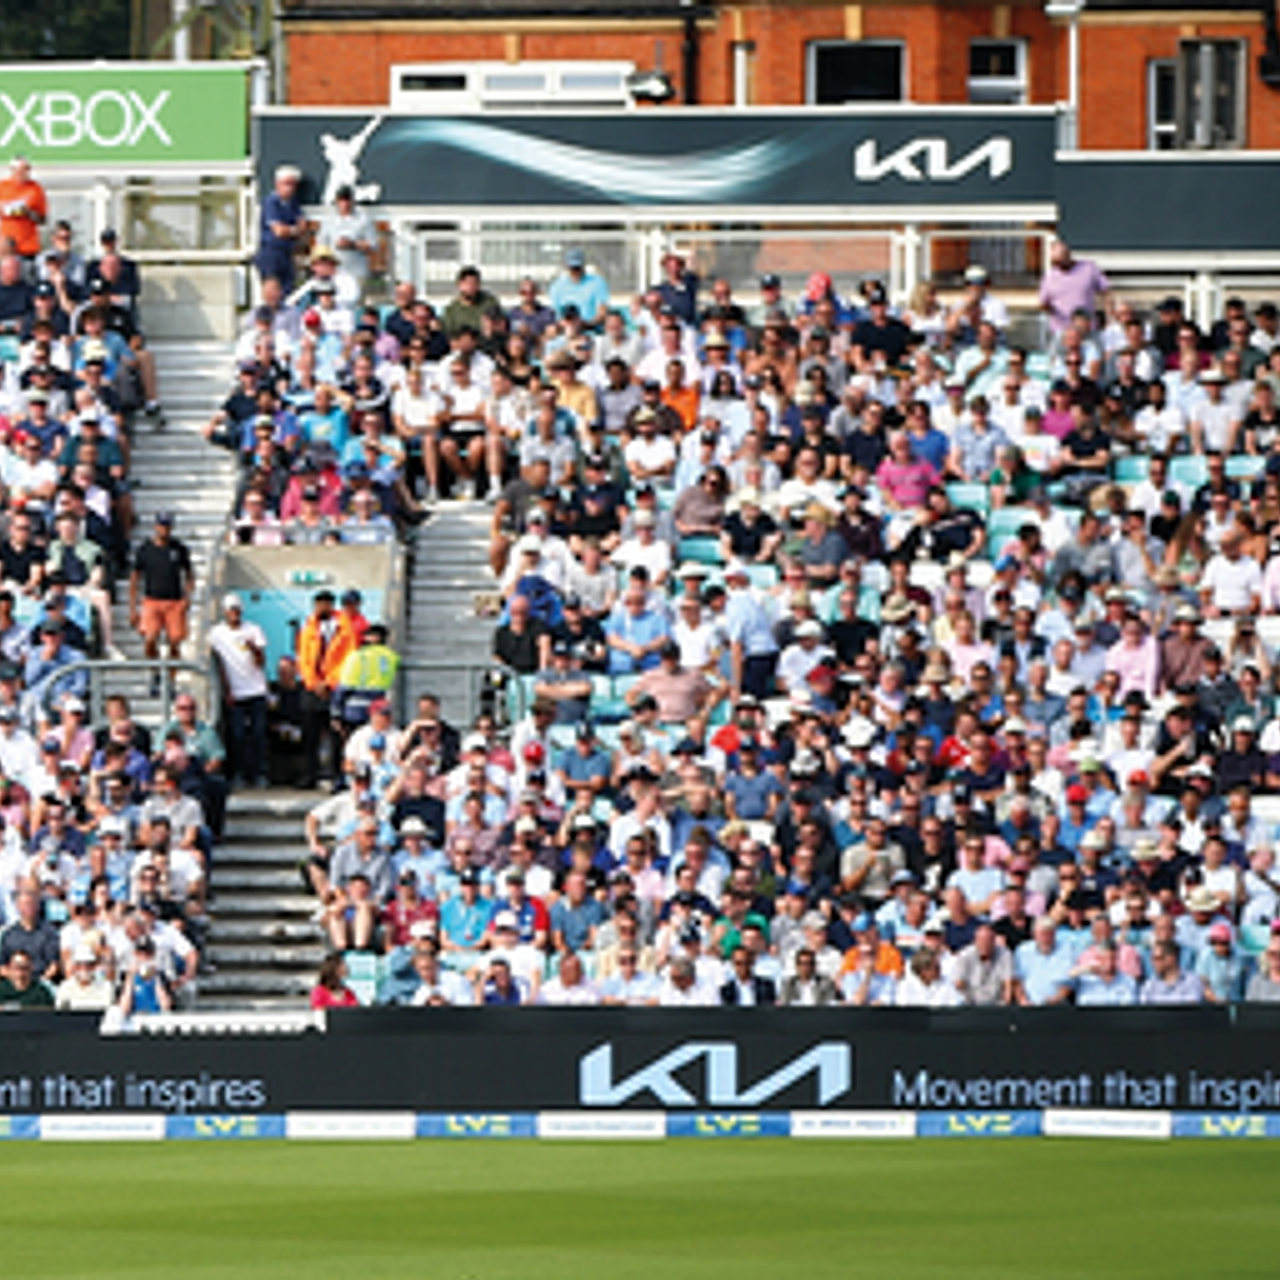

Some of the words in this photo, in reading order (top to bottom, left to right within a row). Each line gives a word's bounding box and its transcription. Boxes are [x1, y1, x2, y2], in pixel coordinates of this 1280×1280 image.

[42, 1073, 117, 1109] that
[124, 1072, 267, 1115] inspires
[893, 1069, 1092, 1106] Movement
[1103, 1070, 1178, 1106] that
